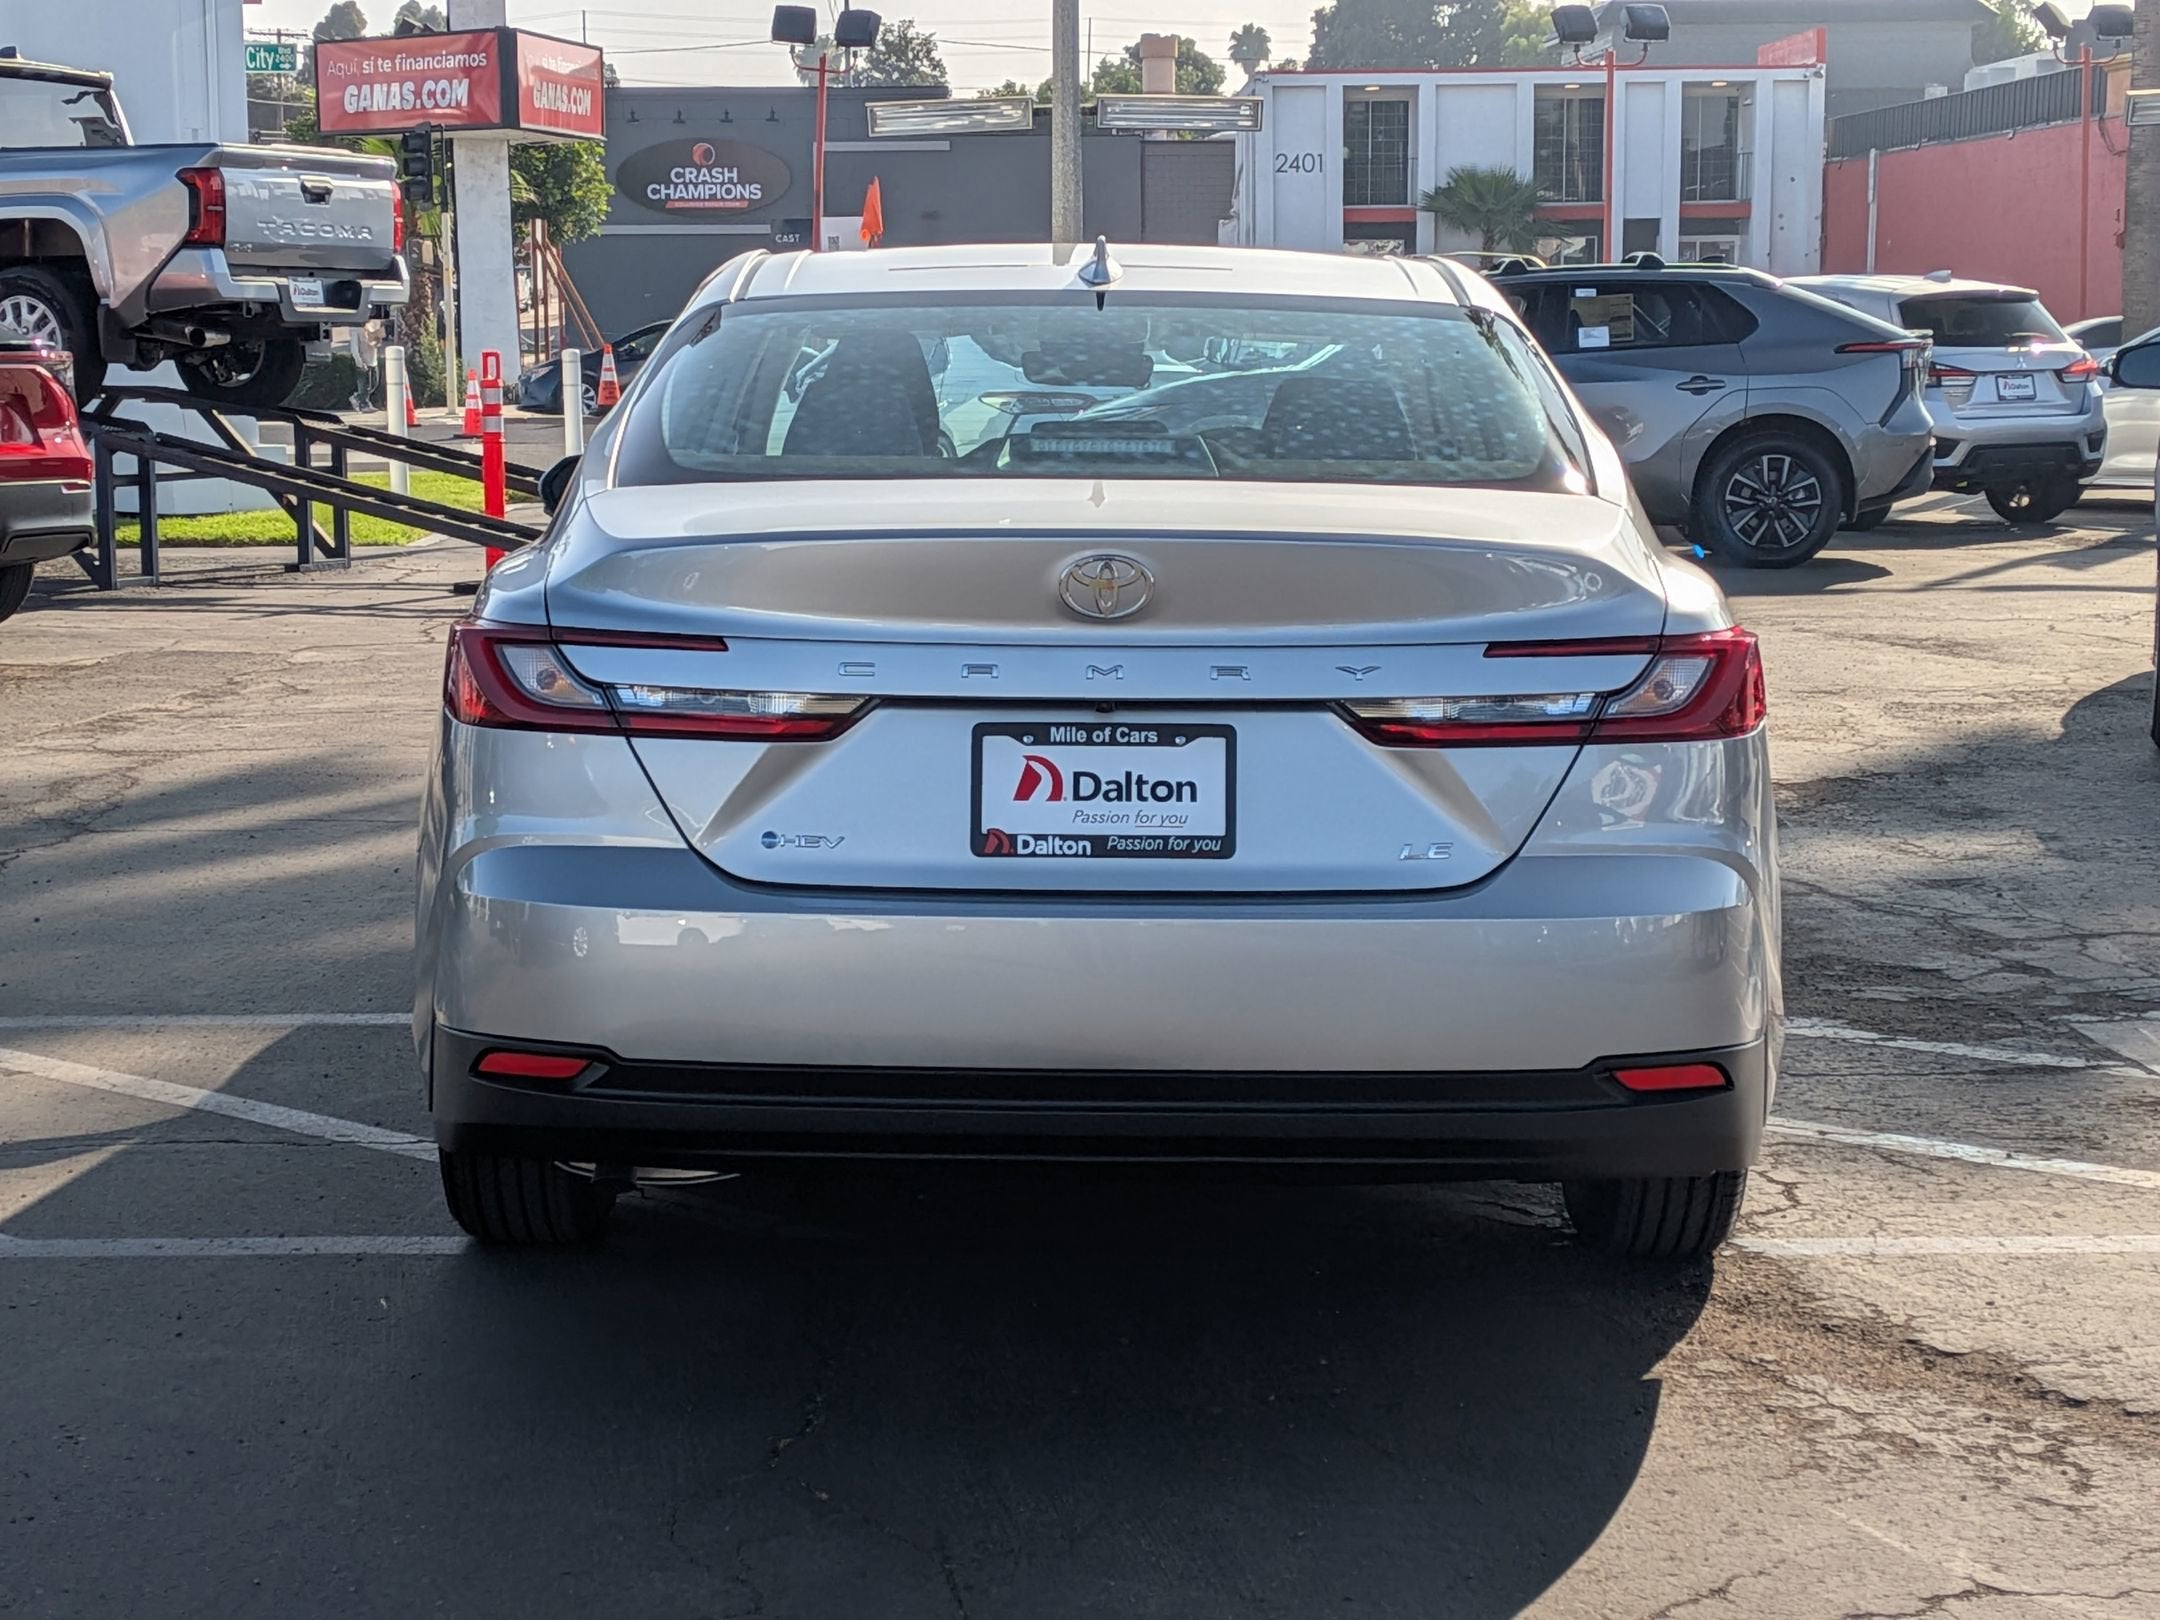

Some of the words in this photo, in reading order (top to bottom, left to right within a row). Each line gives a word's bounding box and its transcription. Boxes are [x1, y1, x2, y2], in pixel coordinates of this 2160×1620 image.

[246, 46, 275, 70] City
[362, 56, 375, 74] sí
[377, 57, 392, 73] te
[395, 50, 487, 72] financiamos
[344, 78, 470, 114] GANAS.COM
[533, 79, 592, 117] GANAS.COM
[1275, 153, 1323, 174] 2401
[670, 167, 738, 183] CRASH
[646, 183, 762, 200] CHAMPIONS
[257, 220, 373, 240] TACOMA
[1050, 726, 1086, 743] Mile
[1092, 726, 1111, 743] of
[1115, 727, 1158, 743] Cars
[1072, 771, 1197, 802] Dalton
[1072, 810, 1130, 825] Passion
[1134, 810, 1155, 826] for
[1160, 814, 1188, 826] you
[1017, 835, 1092, 855] Dalton
[1106, 836, 1166, 851] Passion
[1167, 836, 1190, 851] for
[1193, 839, 1221, 853] you
[1399, 842, 1454, 861] LE
